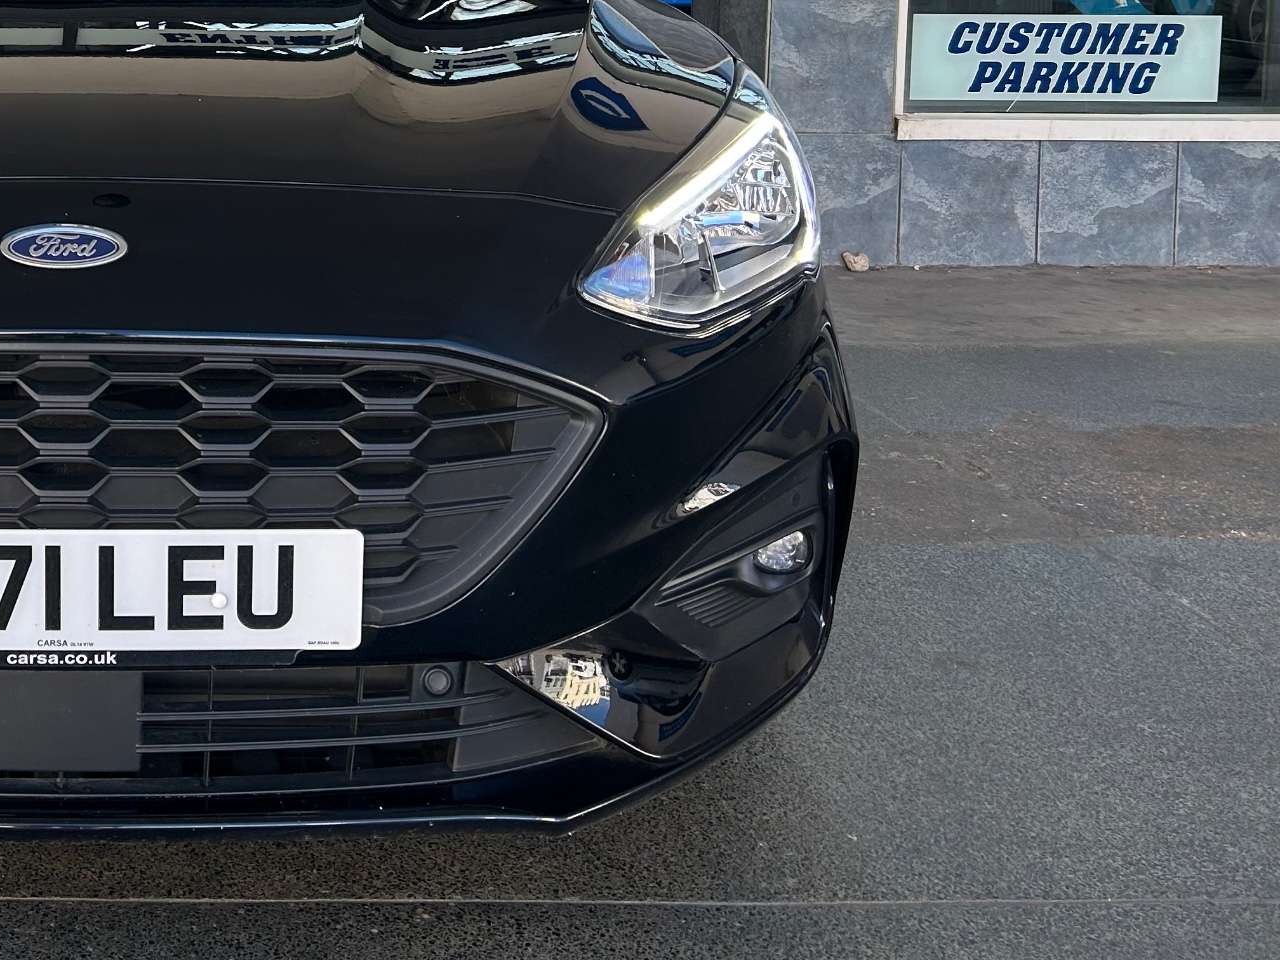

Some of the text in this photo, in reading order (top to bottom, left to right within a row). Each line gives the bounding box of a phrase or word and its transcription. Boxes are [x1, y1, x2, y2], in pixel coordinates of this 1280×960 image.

[947, 21, 1185, 56] CUSTOMER
[967, 61, 1161, 95] PARKING
[28, 232, 98, 257] Ford
[98, 544, 295, 631] LEU
[37, 639, 68, 647] CARSA
[6, 651, 117, 665] carsa.co.uk
